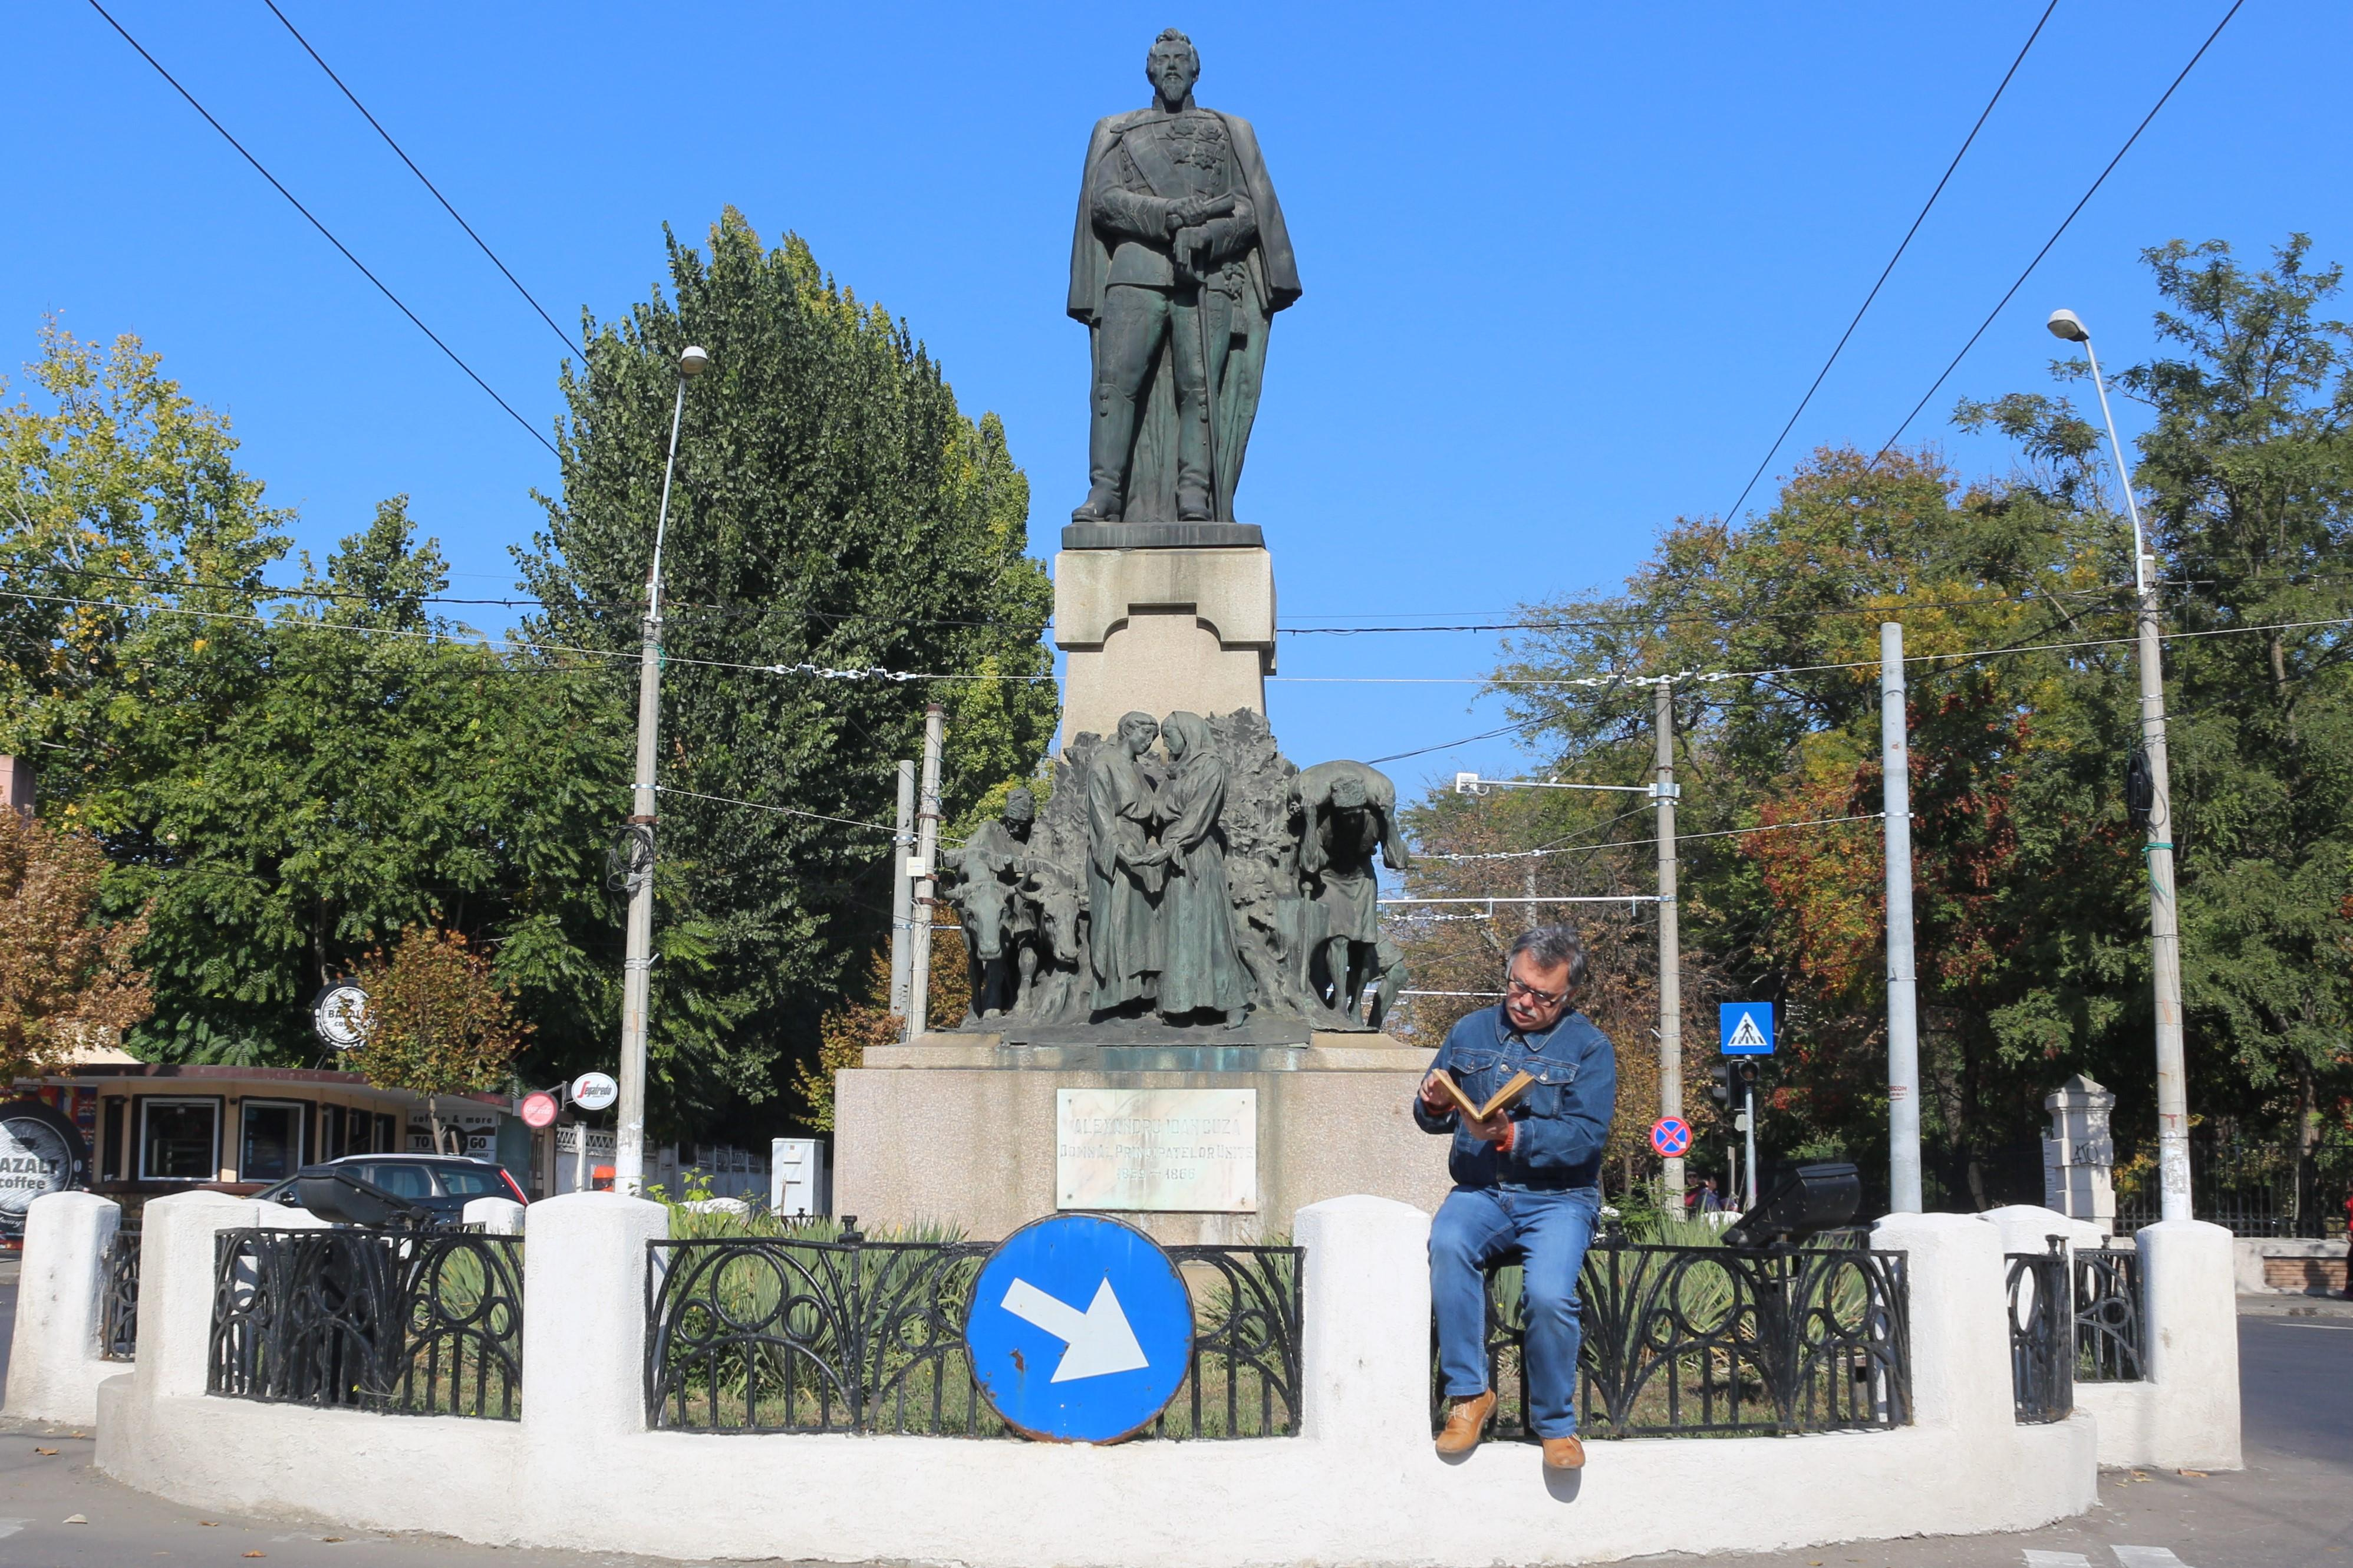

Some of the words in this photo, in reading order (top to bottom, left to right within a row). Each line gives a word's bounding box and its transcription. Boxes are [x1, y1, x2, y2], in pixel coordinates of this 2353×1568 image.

[1075, 1119, 1161, 1135] ALEXANDRU
[1166, 1119, 1199, 1135] IOAN
[1202, 1119, 1241, 1135] CUZA
[414, 1135, 430, 1148] TO
[470, 1137, 487, 1149] GO
[1116, 1144, 1215, 1159] PRINCIPATELOR
[0, 1158, 60, 1174] AZALT
[1166, 1168, 1196, 1180] 1866
